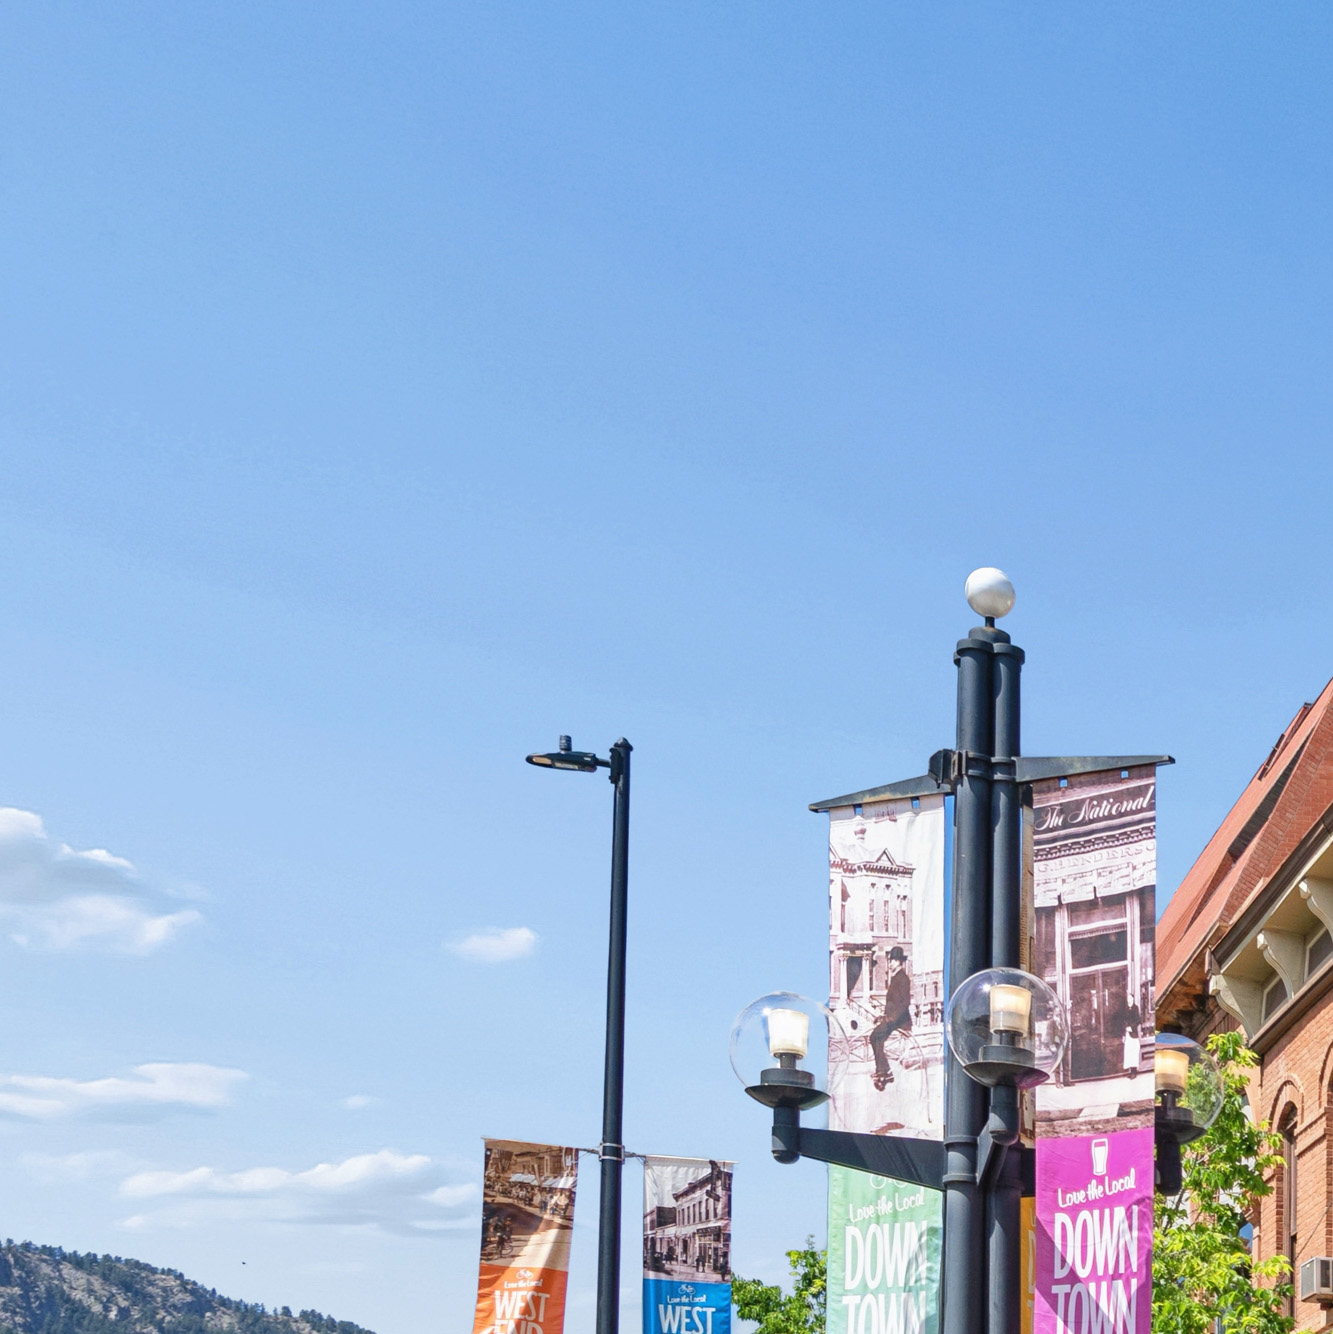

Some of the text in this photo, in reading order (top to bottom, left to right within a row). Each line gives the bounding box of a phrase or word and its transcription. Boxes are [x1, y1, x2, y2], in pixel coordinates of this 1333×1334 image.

[1035, 785, 1155, 831] The National
[849, 1186, 925, 1222] Love the Local
[1058, 1167, 1136, 1208] Love the Local
[845, 1220, 927, 1290] DOWN
[1054, 1205, 1138, 1279] DOWN
[494, 1290, 550, 1322] WEST
